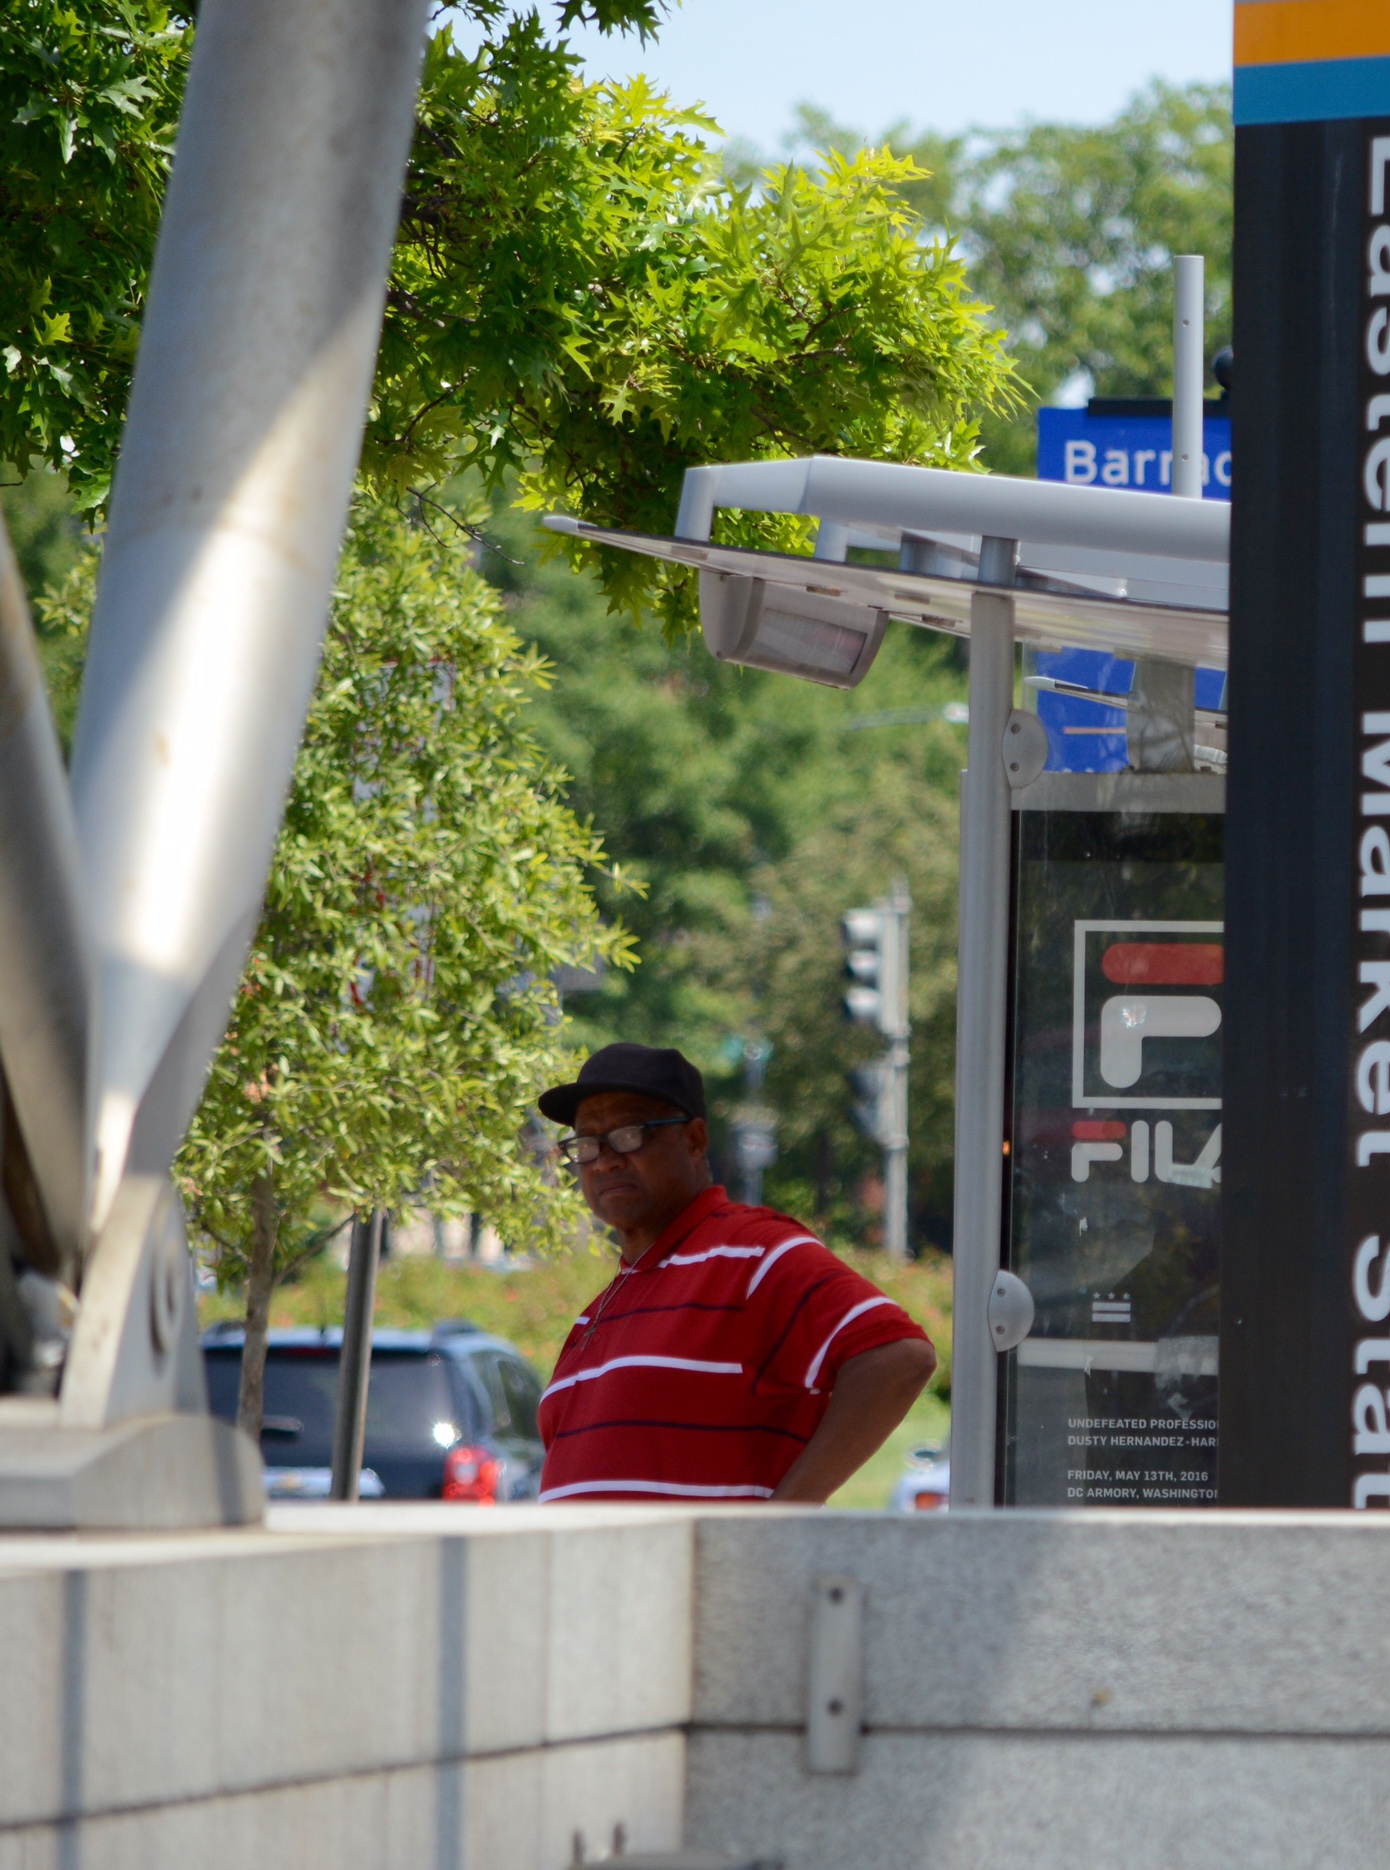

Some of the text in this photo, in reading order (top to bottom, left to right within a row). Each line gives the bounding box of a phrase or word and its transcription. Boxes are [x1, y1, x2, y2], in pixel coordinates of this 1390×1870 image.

[1068, 1418, 1219, 1430] UNDEFEATED PROFESSIO
[1067, 1436, 1219, 1448] DUSTY HERNANDEZ-HAR
[1067, 1470, 1209, 1483] FRIDAY, MAY 13TH, 2016
[1067, 1487, 1084, 1498] DC
[1087, 1487, 1140, 1500] ARMORY,
